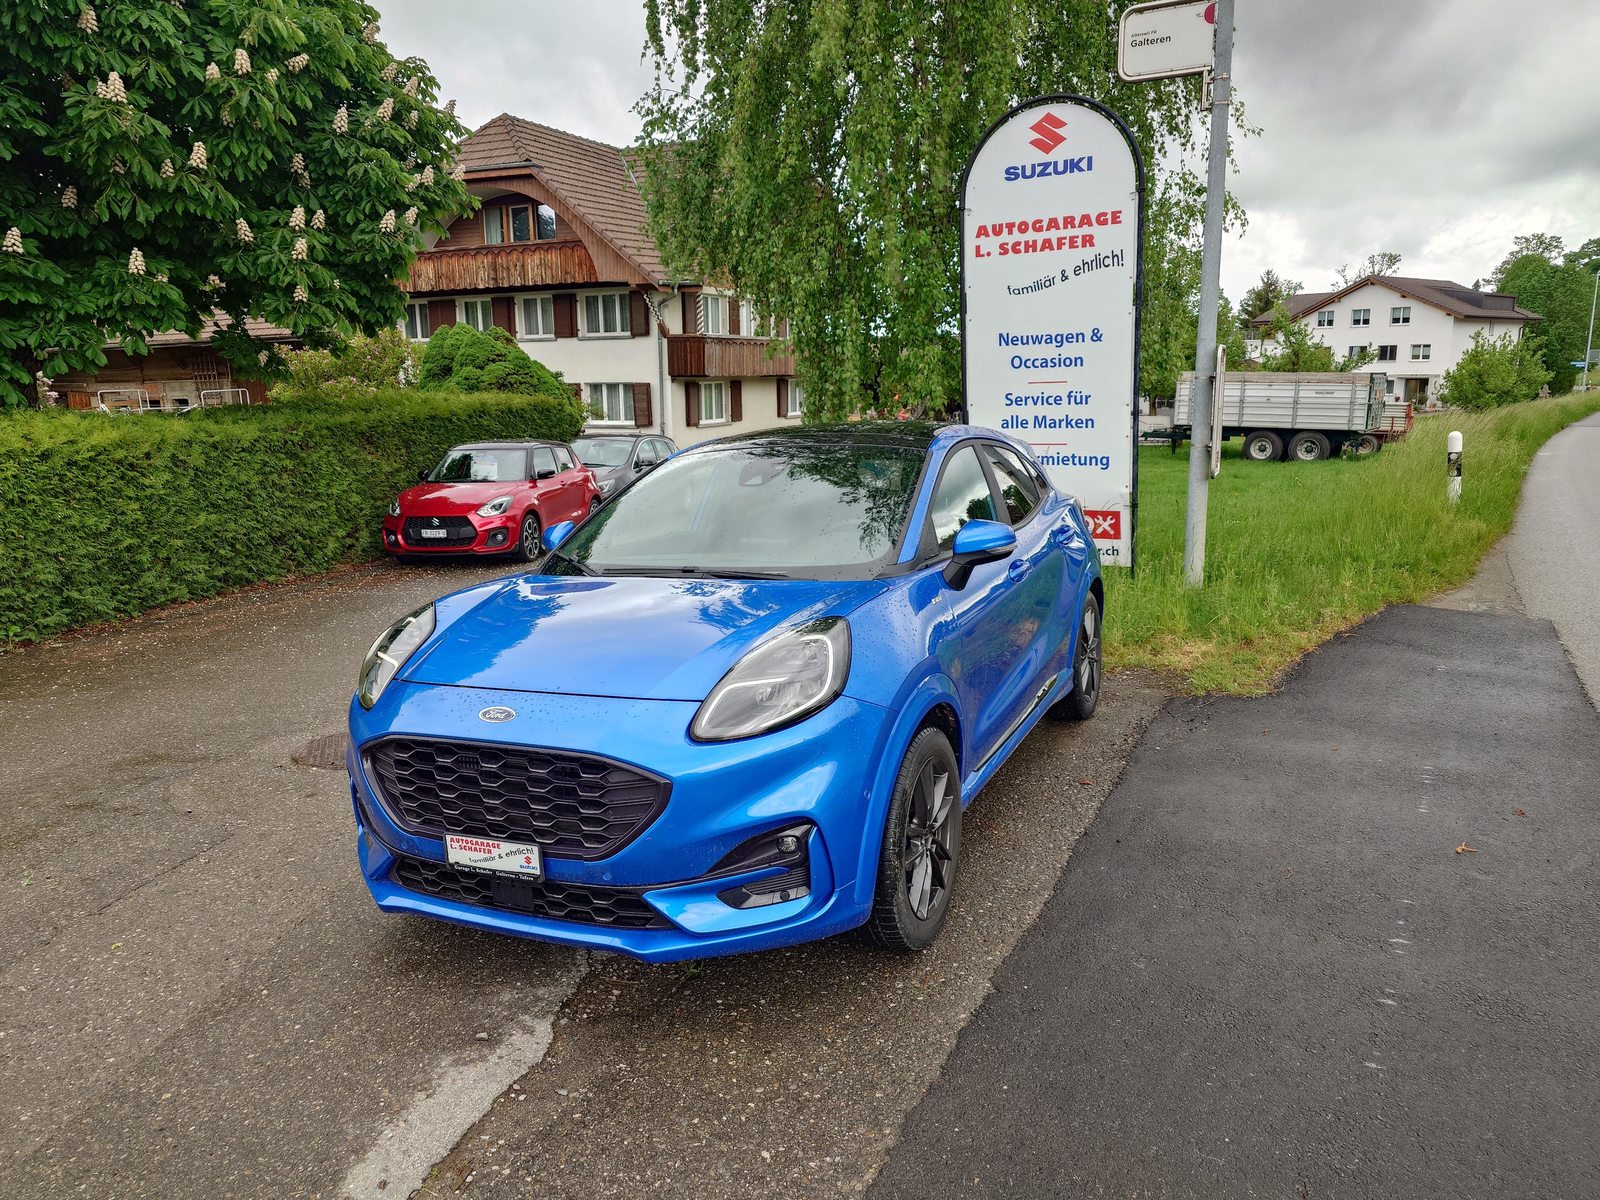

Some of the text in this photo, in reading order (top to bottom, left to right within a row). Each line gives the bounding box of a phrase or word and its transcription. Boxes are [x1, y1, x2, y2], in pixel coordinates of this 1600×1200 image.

[1131, 35, 1171, 47] Galteren
[1004, 155, 1093, 182] SUZUKI
[975, 210, 1122, 238] AUTOGARAGE
[974, 233, 1096, 258] L. SCHAFER
[1007, 248, 1125, 296] familiär & ehrlich!
[998, 327, 1104, 348] Neuwagen &
[1010, 353, 1085, 370] Occasion
[1004, 390, 1092, 407] Service für
[1000, 414, 1096, 430] alle Marken
[1037, 451, 1110, 470] mietung
[450, 838, 501, 849] AUTOGARAGE
[505, 848, 534, 857] ehrlich!
